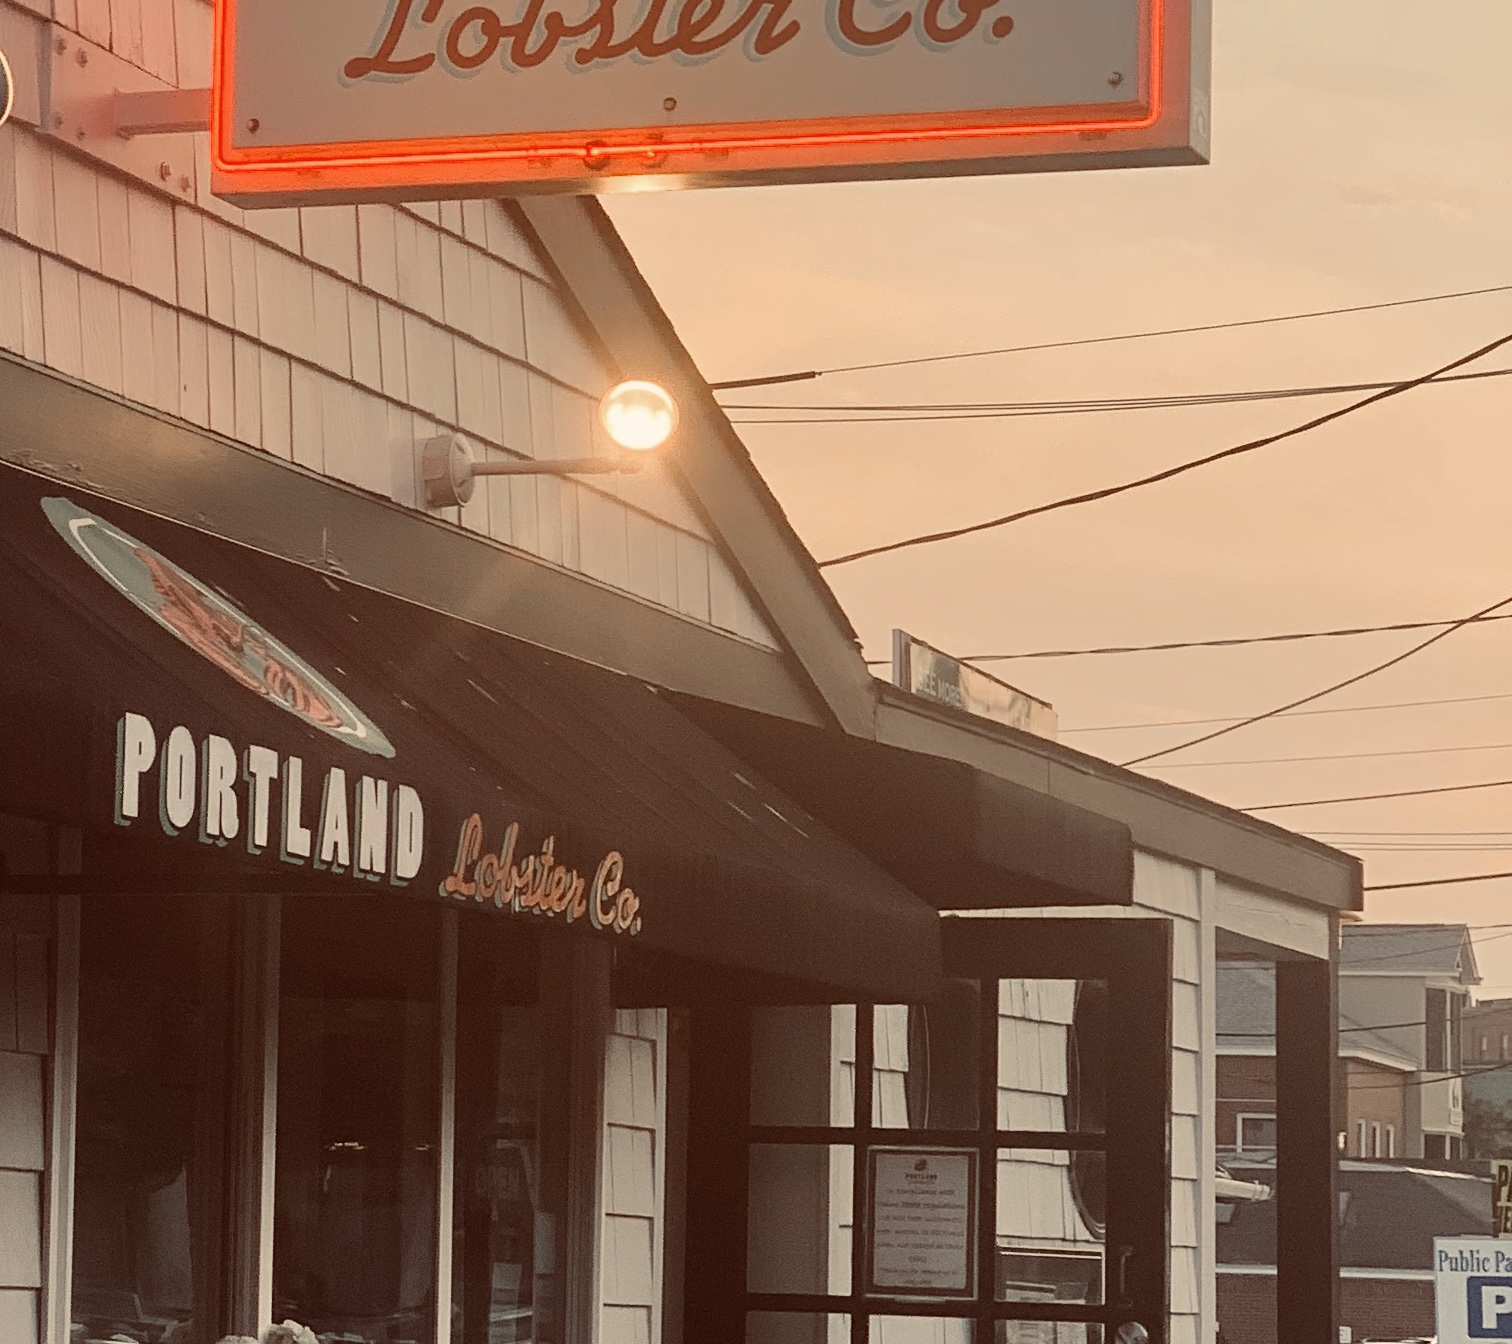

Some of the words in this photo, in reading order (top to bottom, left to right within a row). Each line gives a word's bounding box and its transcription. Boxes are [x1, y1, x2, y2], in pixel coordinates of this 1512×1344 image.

[116, 711, 425, 884] PORTLAND
[440, 812, 586, 923] Lobster
[591, 851, 642, 935] Co.
[1438, 1249, 1490, 1272] Public
[1481, 1285, 1512, 1329] P
